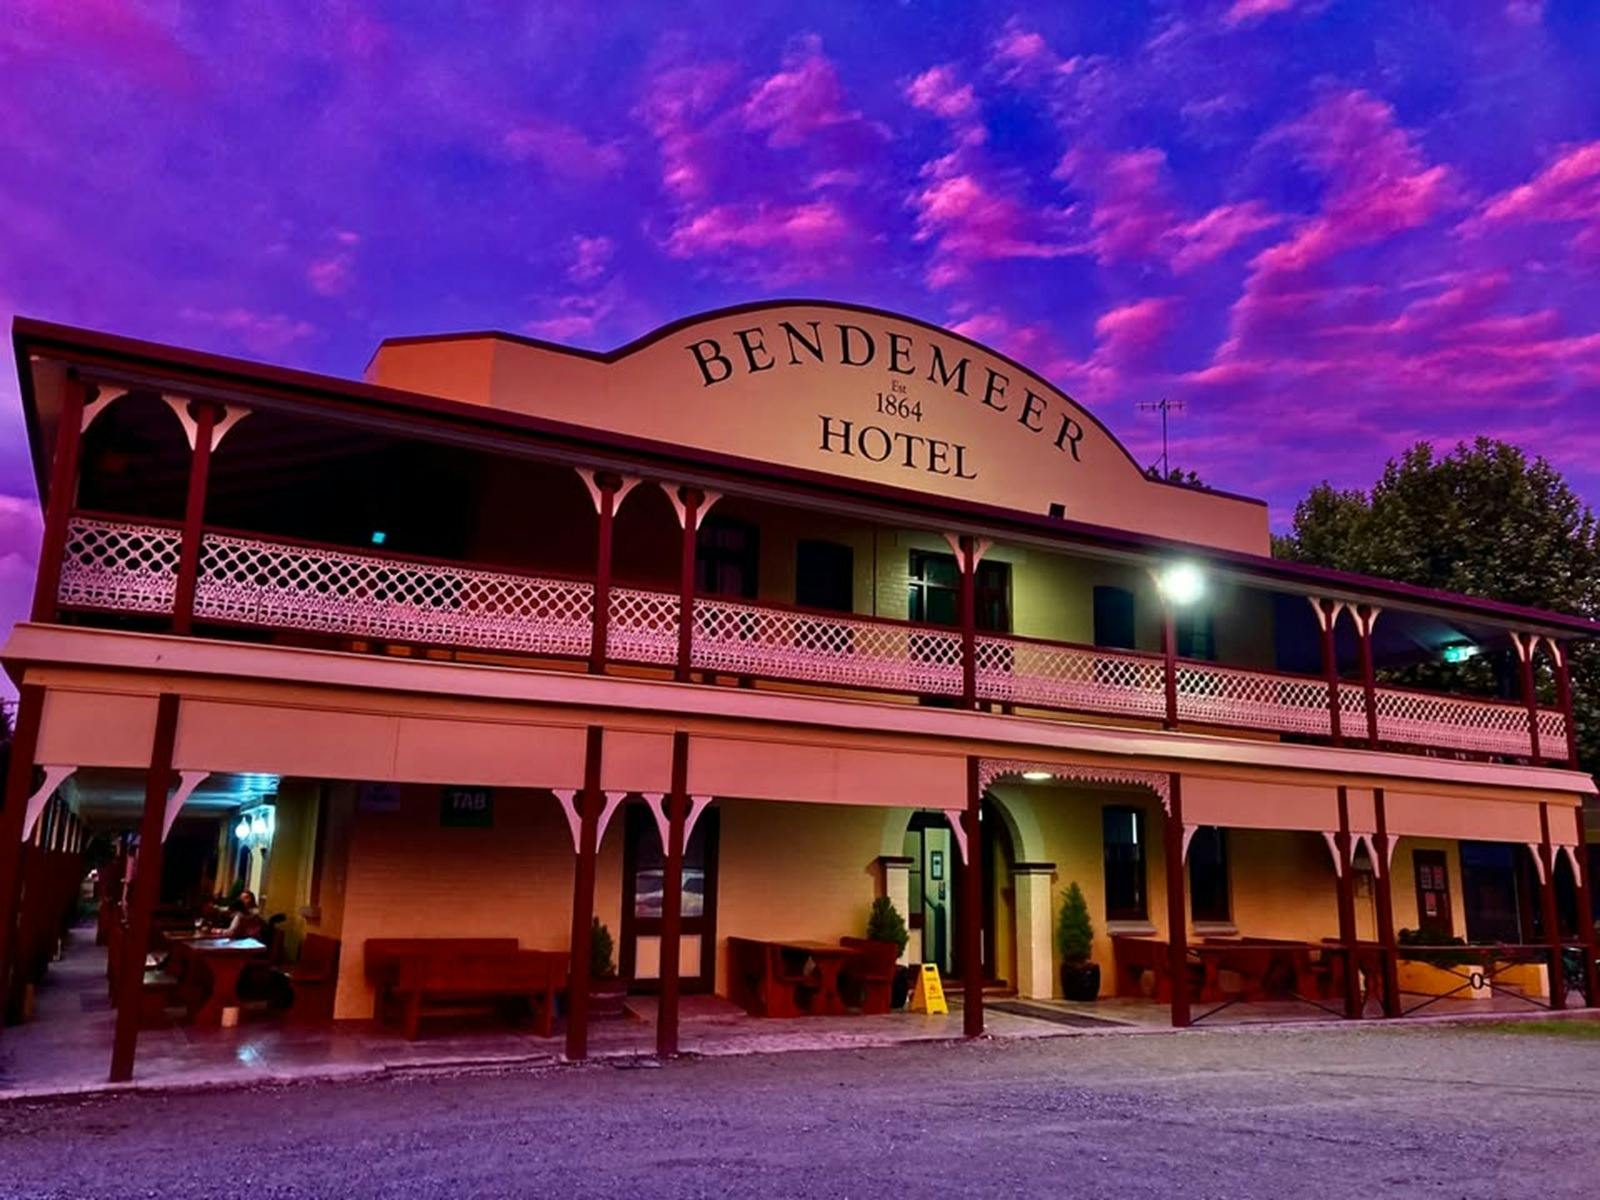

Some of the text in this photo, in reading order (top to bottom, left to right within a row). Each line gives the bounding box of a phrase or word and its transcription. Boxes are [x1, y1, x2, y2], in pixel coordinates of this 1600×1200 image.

[686, 320, 1085, 463] BENDEMEER
[875, 391, 923, 423] 1864
[817, 414, 978, 480] HOTEL
[452, 791, 488, 811] TAB
